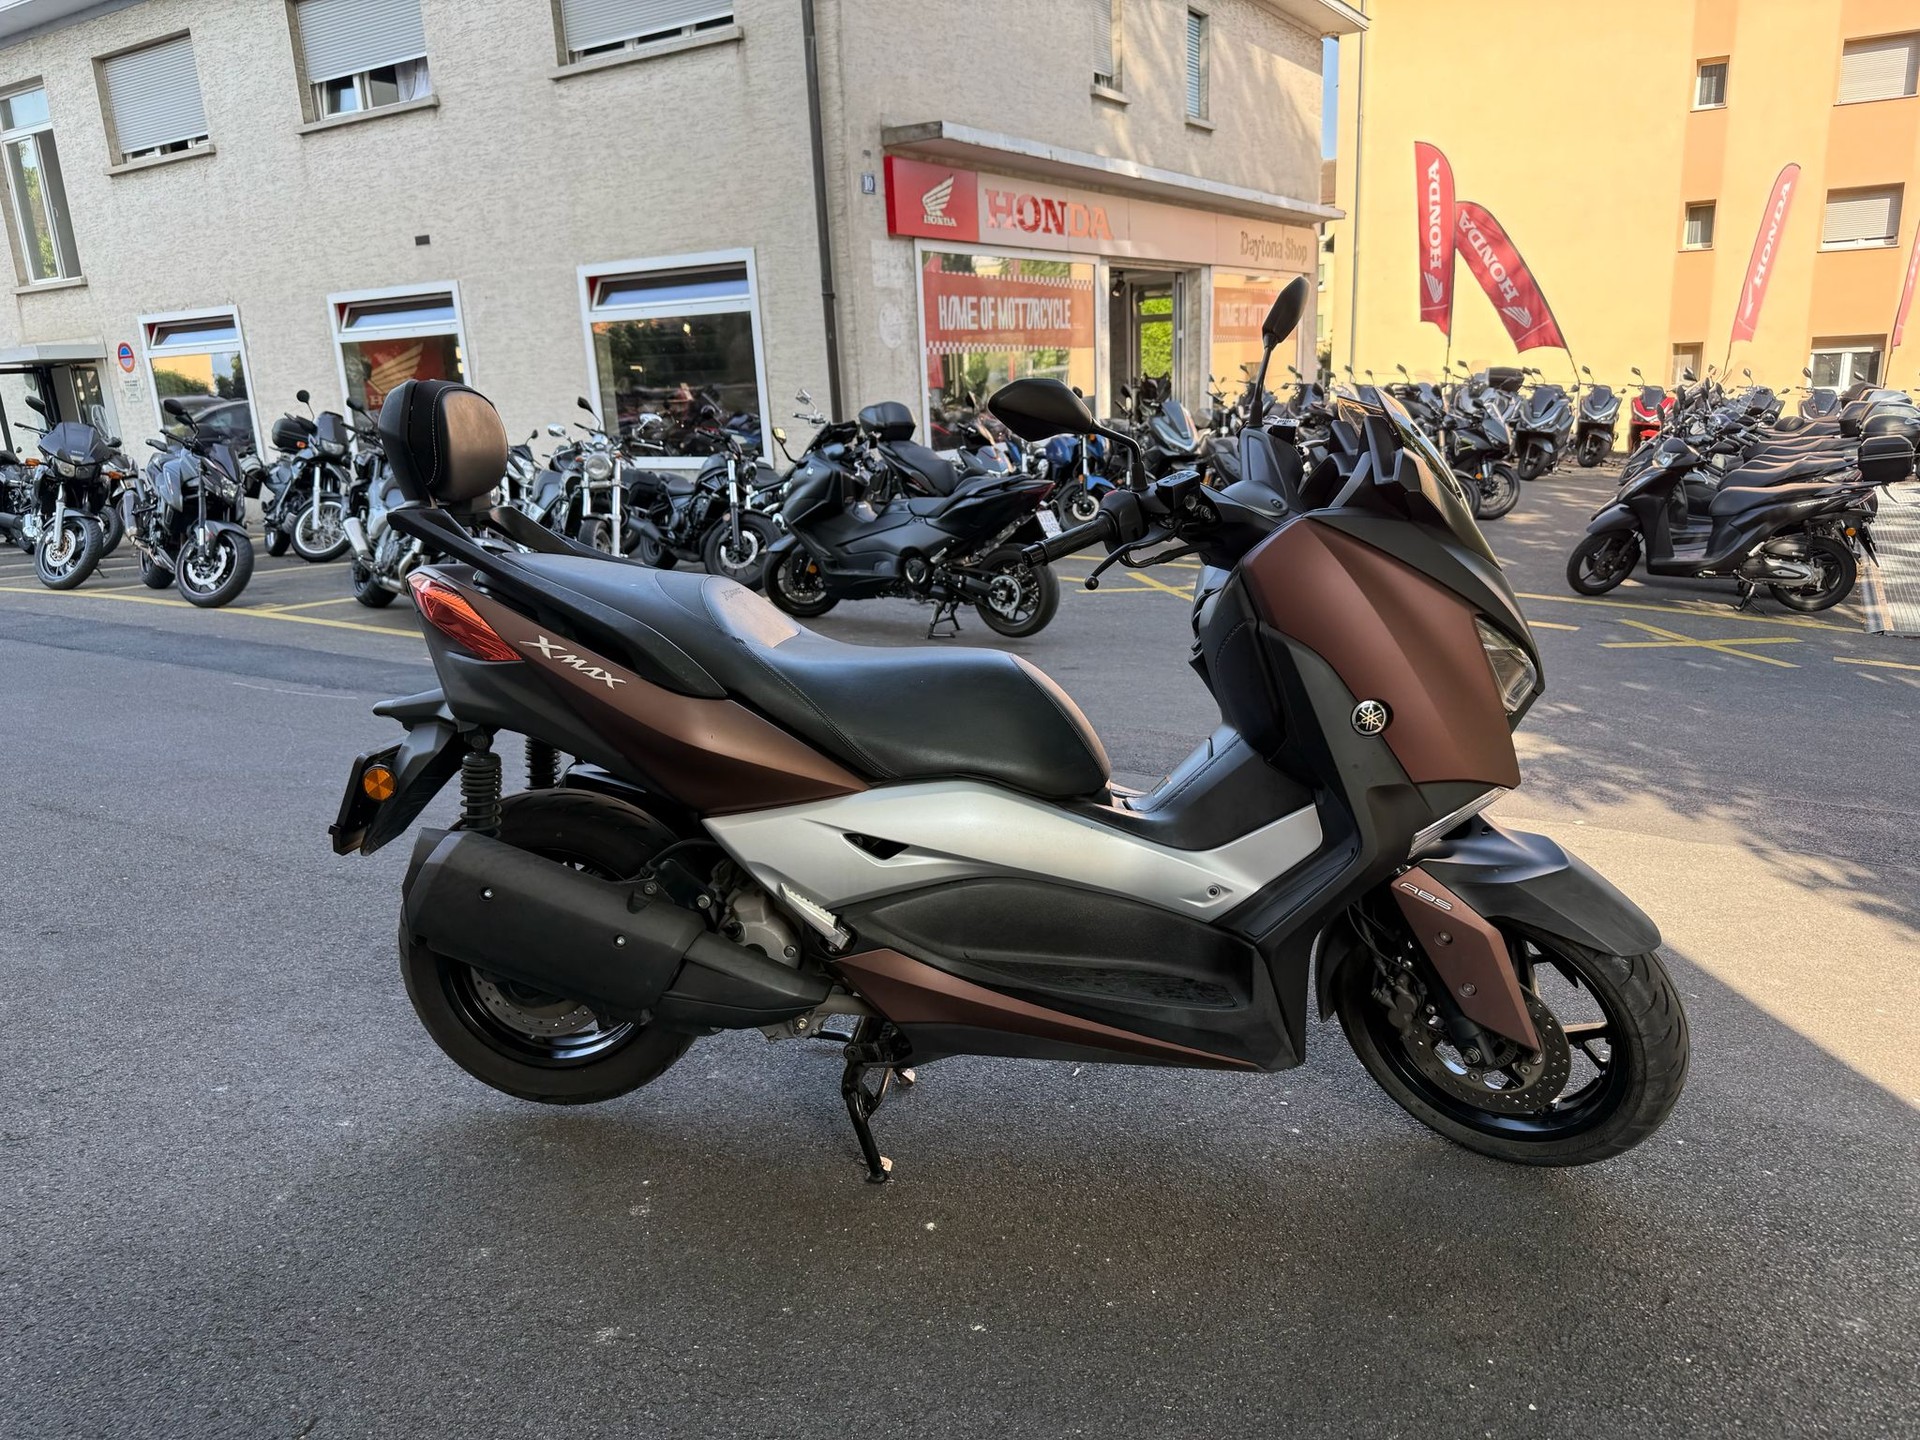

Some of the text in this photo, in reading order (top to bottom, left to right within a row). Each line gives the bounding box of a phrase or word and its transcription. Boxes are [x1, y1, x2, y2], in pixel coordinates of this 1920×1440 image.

[923, 214, 957, 227] HONDA
[984, 188, 1115, 241] HONDA
[1428, 158, 1442, 271] HONDA
[1754, 181, 1792, 288] HONDA
[1240, 230, 1308, 266] Daytona Shop
[1459, 209, 1520, 303] HONDA
[937, 294, 979, 331] HOME
[980, 296, 995, 331] OF
[519, 635, 627, 690] XMAX
[1400, 882, 1453, 911] ABS
